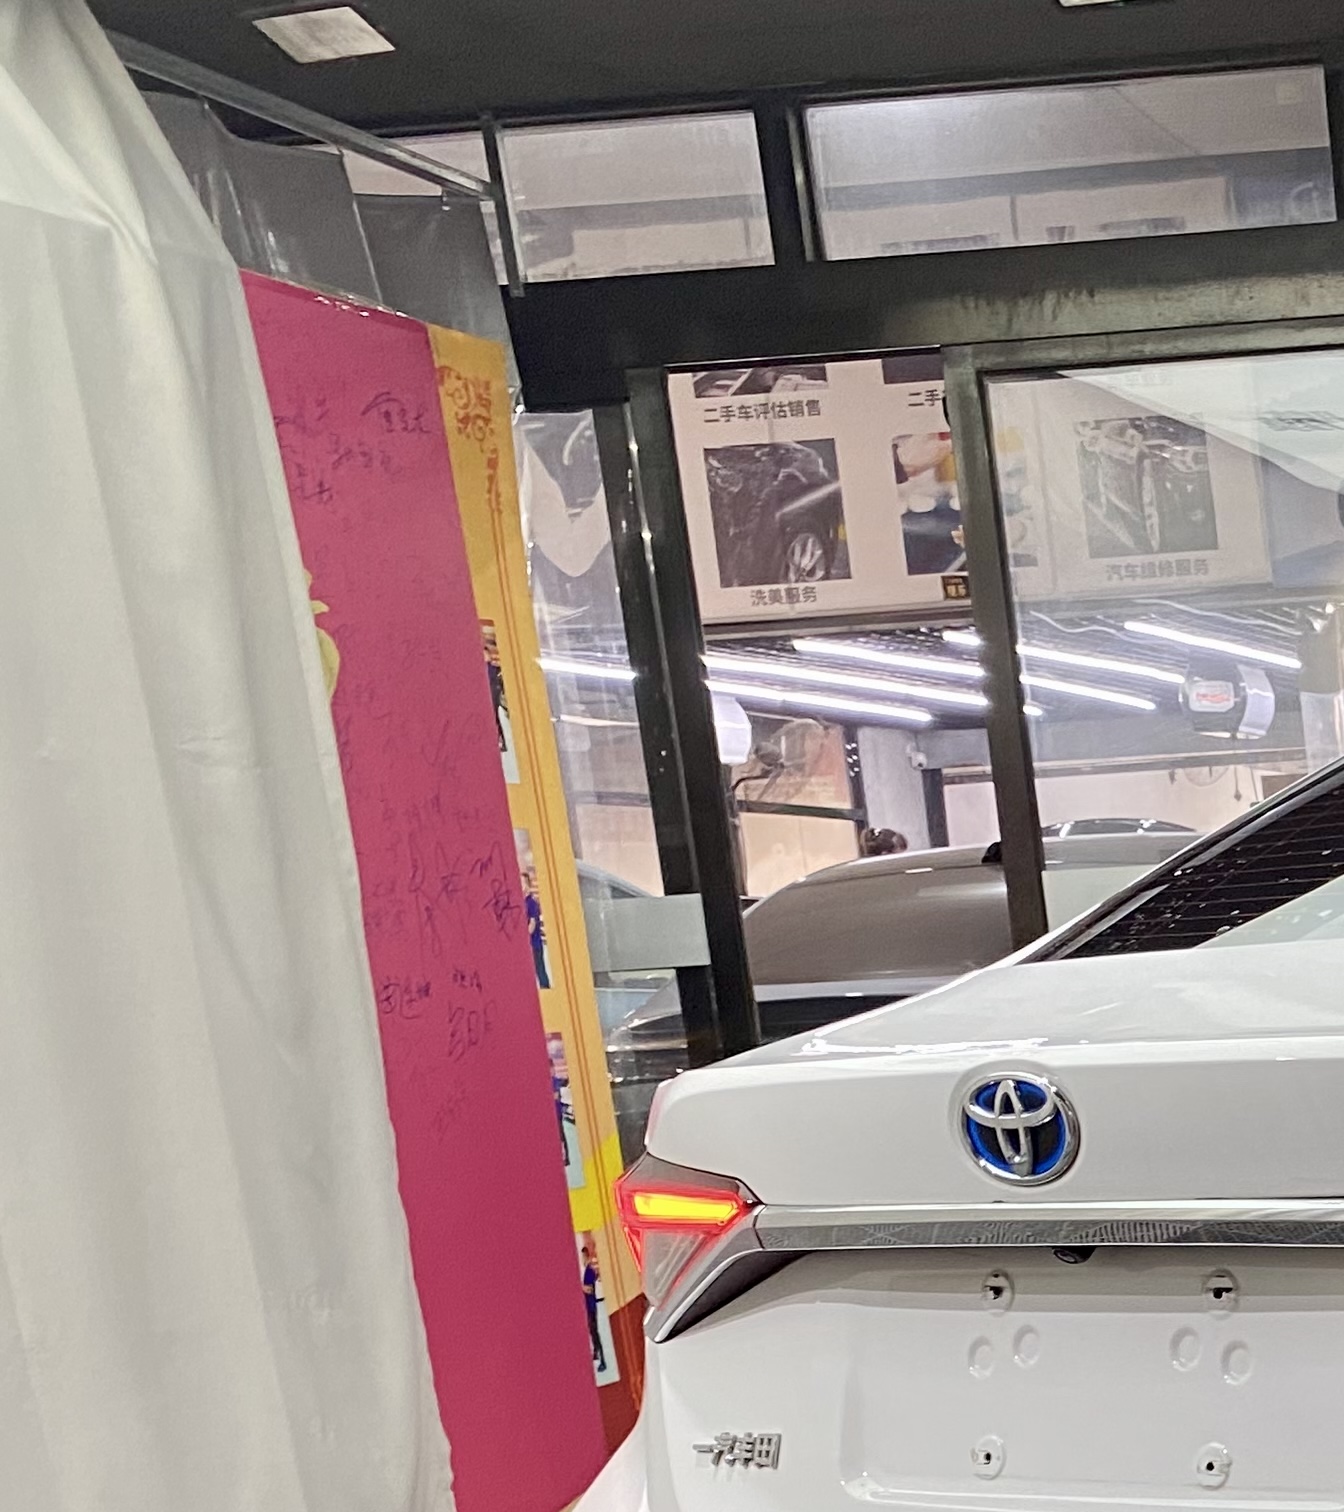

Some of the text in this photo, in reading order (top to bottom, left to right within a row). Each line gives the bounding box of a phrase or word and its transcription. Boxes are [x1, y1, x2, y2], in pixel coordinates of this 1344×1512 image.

[907, 389, 946, 407] 二手
[703, 399, 821, 423] 二手车评估销售
[1105, 558, 1209, 581] 汽车维修服务
